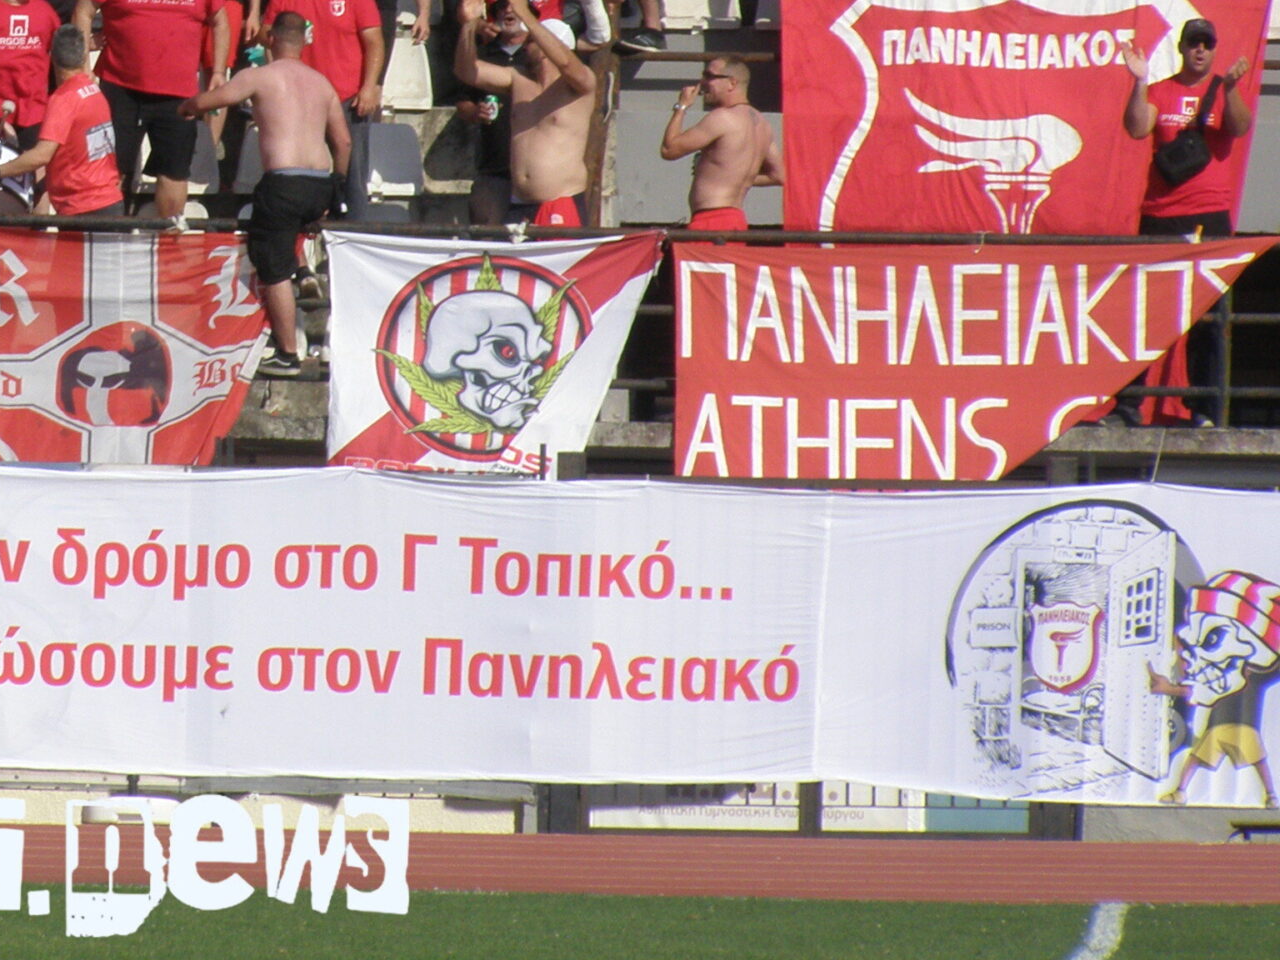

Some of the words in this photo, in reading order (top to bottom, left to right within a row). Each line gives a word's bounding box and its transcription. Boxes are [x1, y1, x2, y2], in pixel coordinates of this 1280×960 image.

[27, 36, 42, 46] AF
[882, 26, 1135, 69] ΠΑΝΗΛΕΙΑΚΟΣ
[681, 393, 1008, 481] ATHENS
[52, 526, 251, 601] δρόμο
[274, 543, 379, 591] στο
[402, 533, 438, 592] Γ
[459, 536, 733, 601] Τοπικό...
[976, 622, 1011, 632] PRISON
[257, 646, 401, 694] στον
[423, 637, 800, 703] Πανηλειακό
